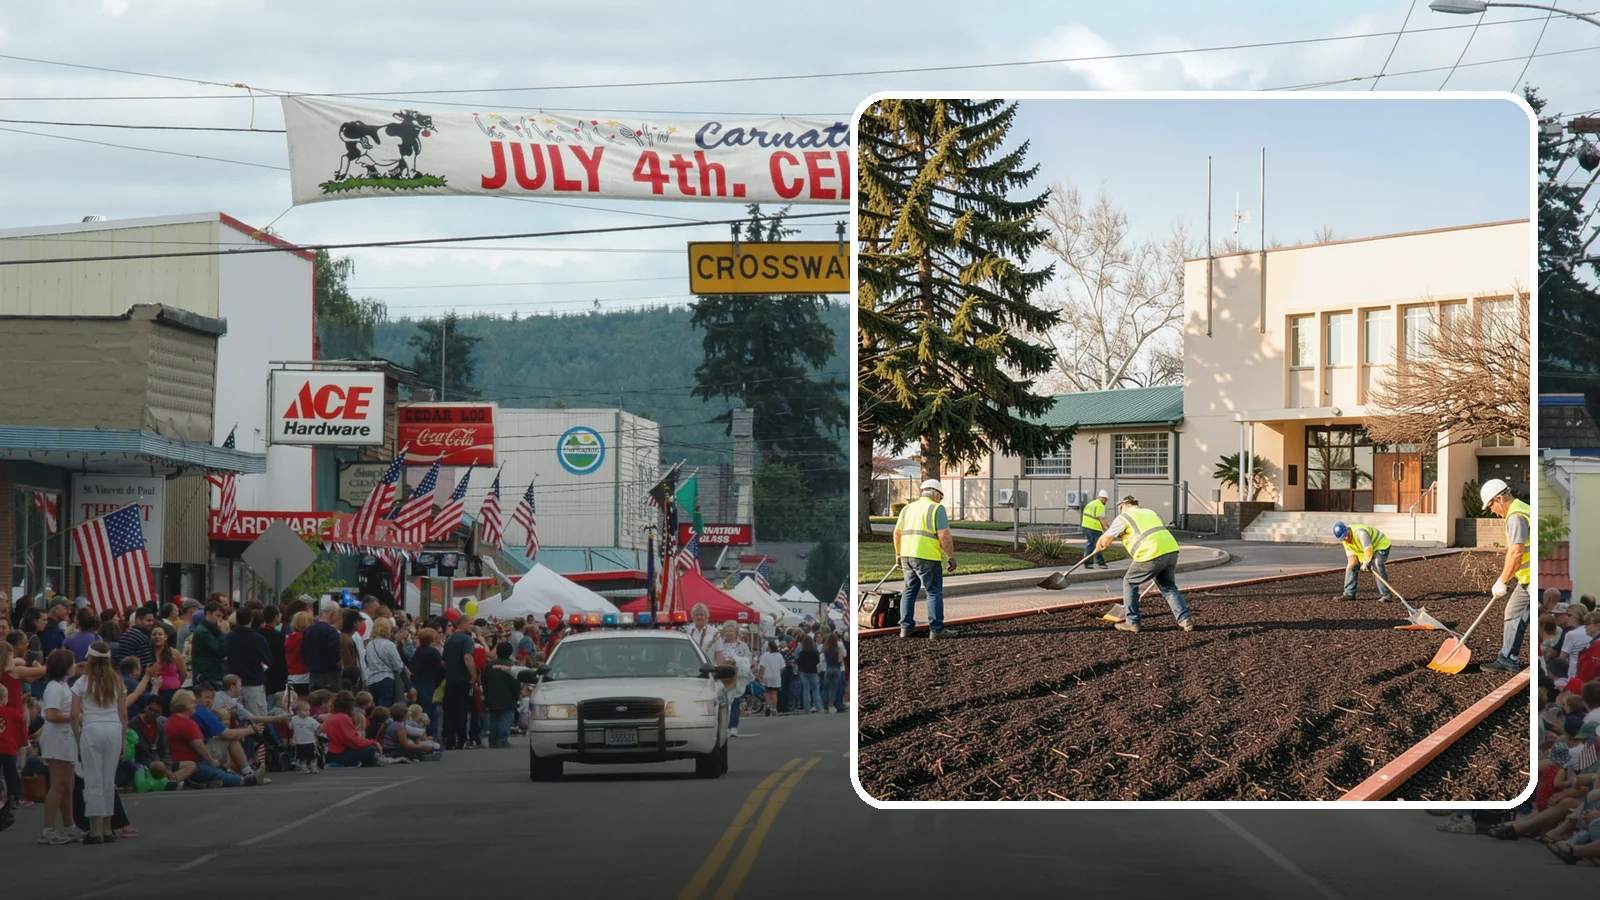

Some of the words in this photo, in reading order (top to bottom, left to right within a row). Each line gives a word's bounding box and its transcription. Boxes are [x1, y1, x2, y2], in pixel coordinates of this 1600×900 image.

[695, 121, 850, 150] Carnat
[481, 141, 605, 192] JULY
[632, 149, 746, 198] 4th.
[697, 254, 850, 280] CROSSWA
[282, 380, 373, 420] ACE
[406, 409, 452, 422] CEDAR
[461, 409, 485, 422] LOG
[283, 421, 370, 436] Hardware
[416, 428, 477, 447] Coca-Cola
[83, 485, 94, 494] St.
[95, 485, 124, 495] Vincent
[126, 486, 136, 495] de
[138, 486, 155, 495] Paul
[688, 526, 742, 535] CRNATION
[699, 535, 730, 543] GLASS
